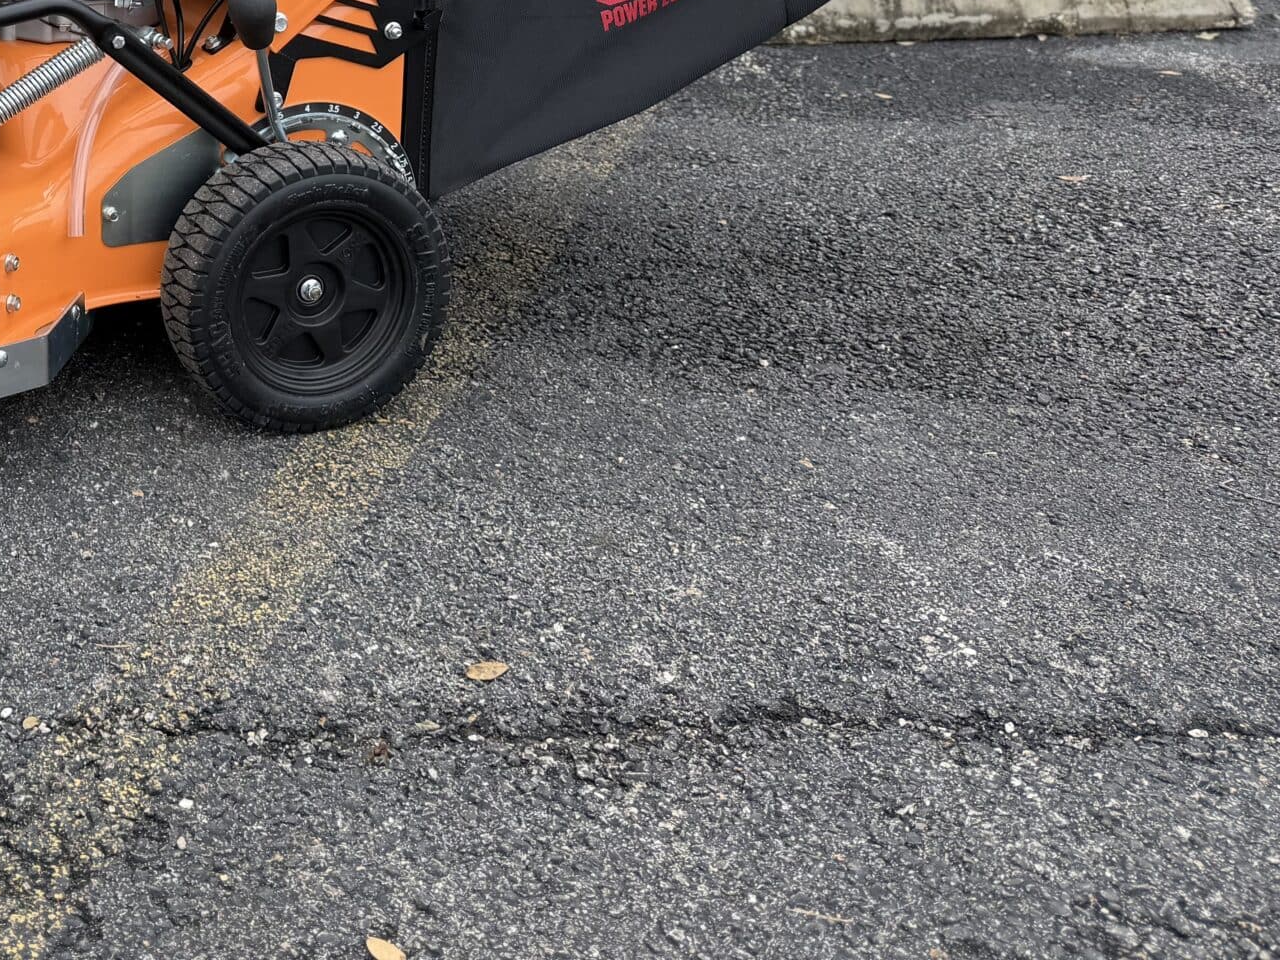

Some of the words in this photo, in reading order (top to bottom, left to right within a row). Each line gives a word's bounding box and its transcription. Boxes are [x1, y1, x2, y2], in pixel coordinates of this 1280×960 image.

[327, 104, 340, 113] 3.5
[353, 111, 360, 119] 3
[371, 122, 384, 134] 2.5
[390, 142, 398, 150] 2
